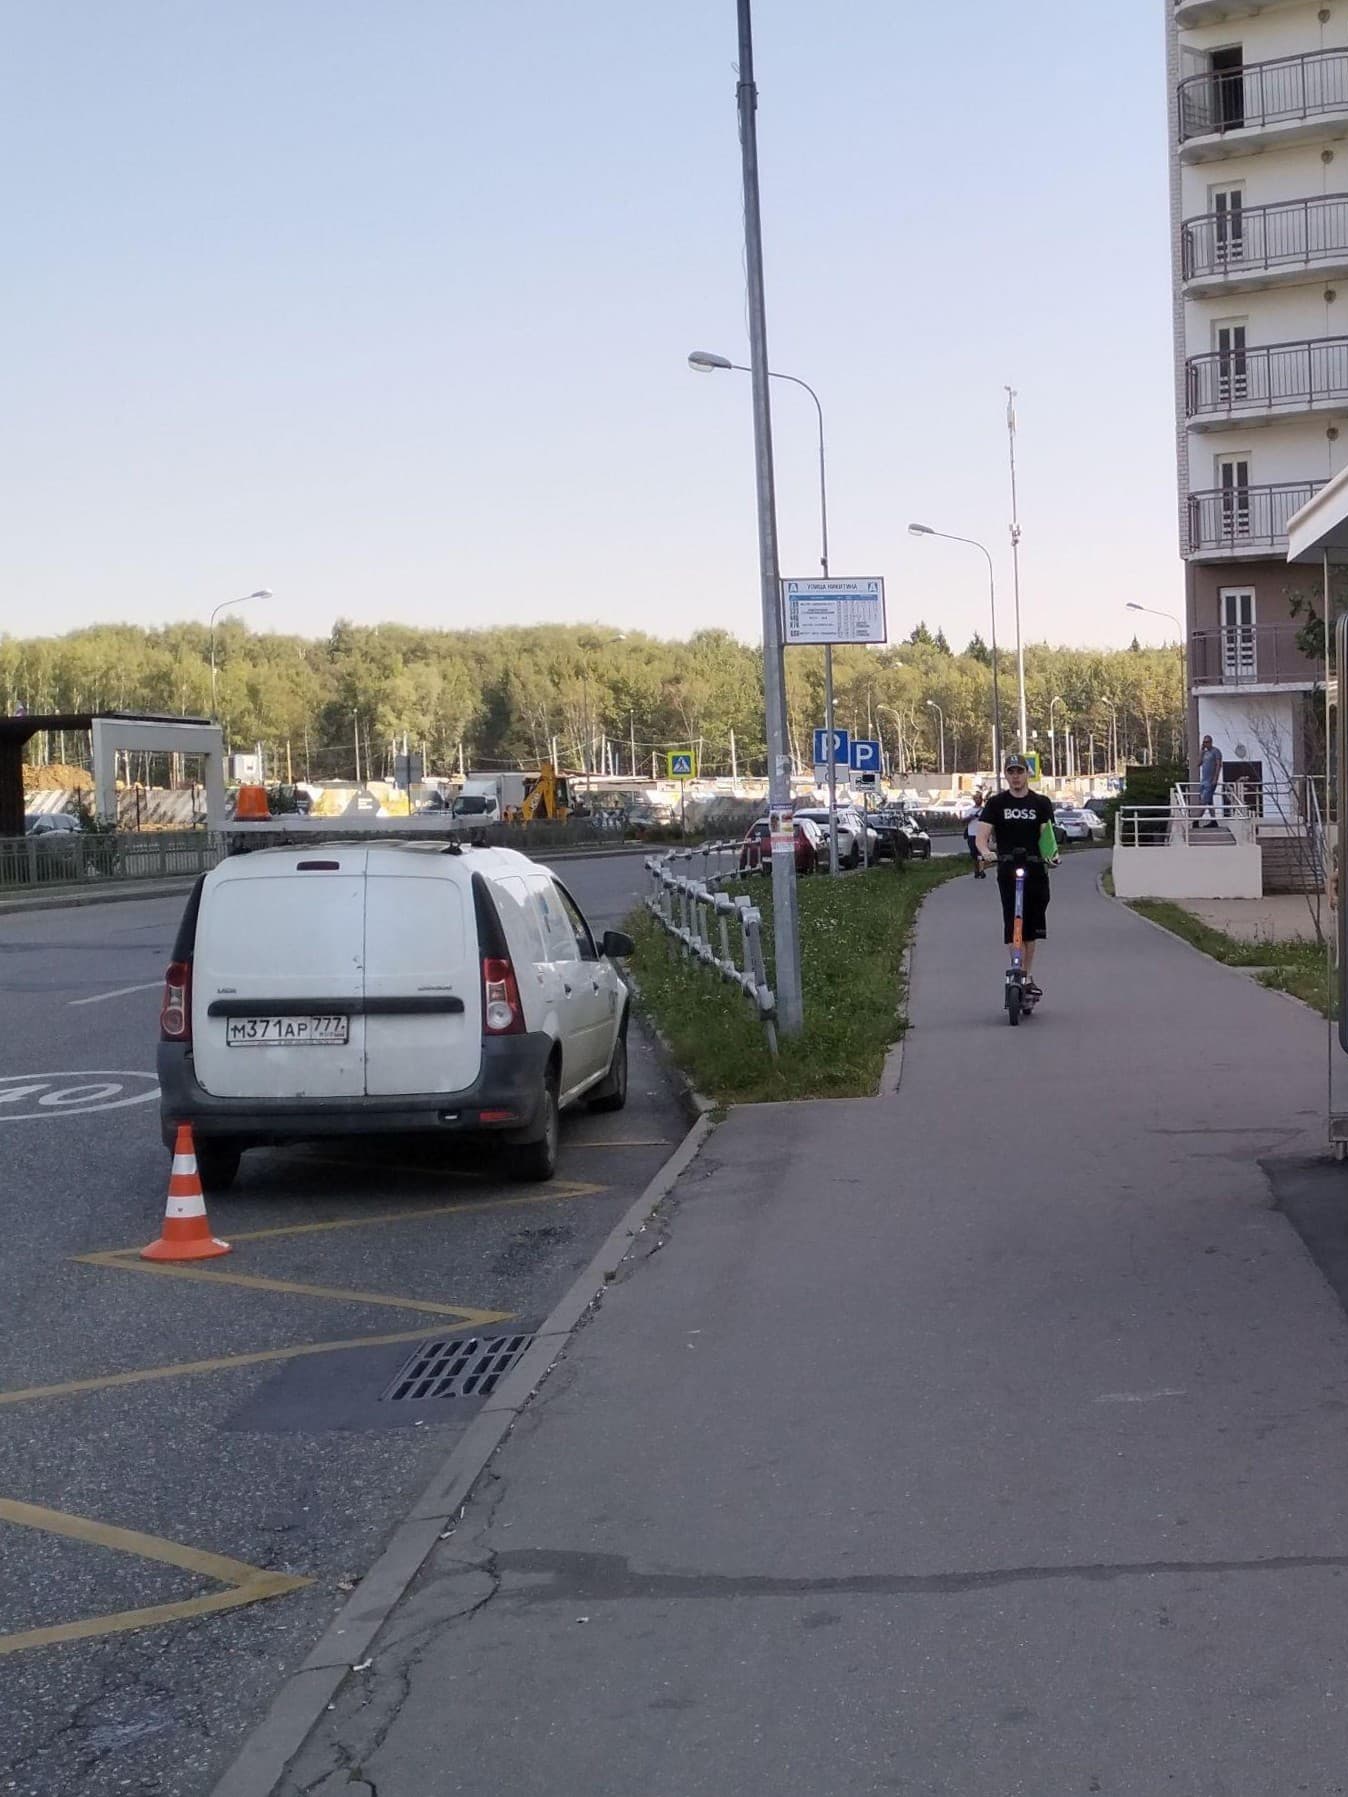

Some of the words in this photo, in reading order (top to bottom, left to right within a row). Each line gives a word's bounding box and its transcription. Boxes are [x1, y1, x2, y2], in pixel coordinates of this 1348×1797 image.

[821, 733, 840, 761] P
[856, 744, 873, 768] P
[1003, 808, 1037, 820] BOSS
[312, 1017, 341, 1032] 777
